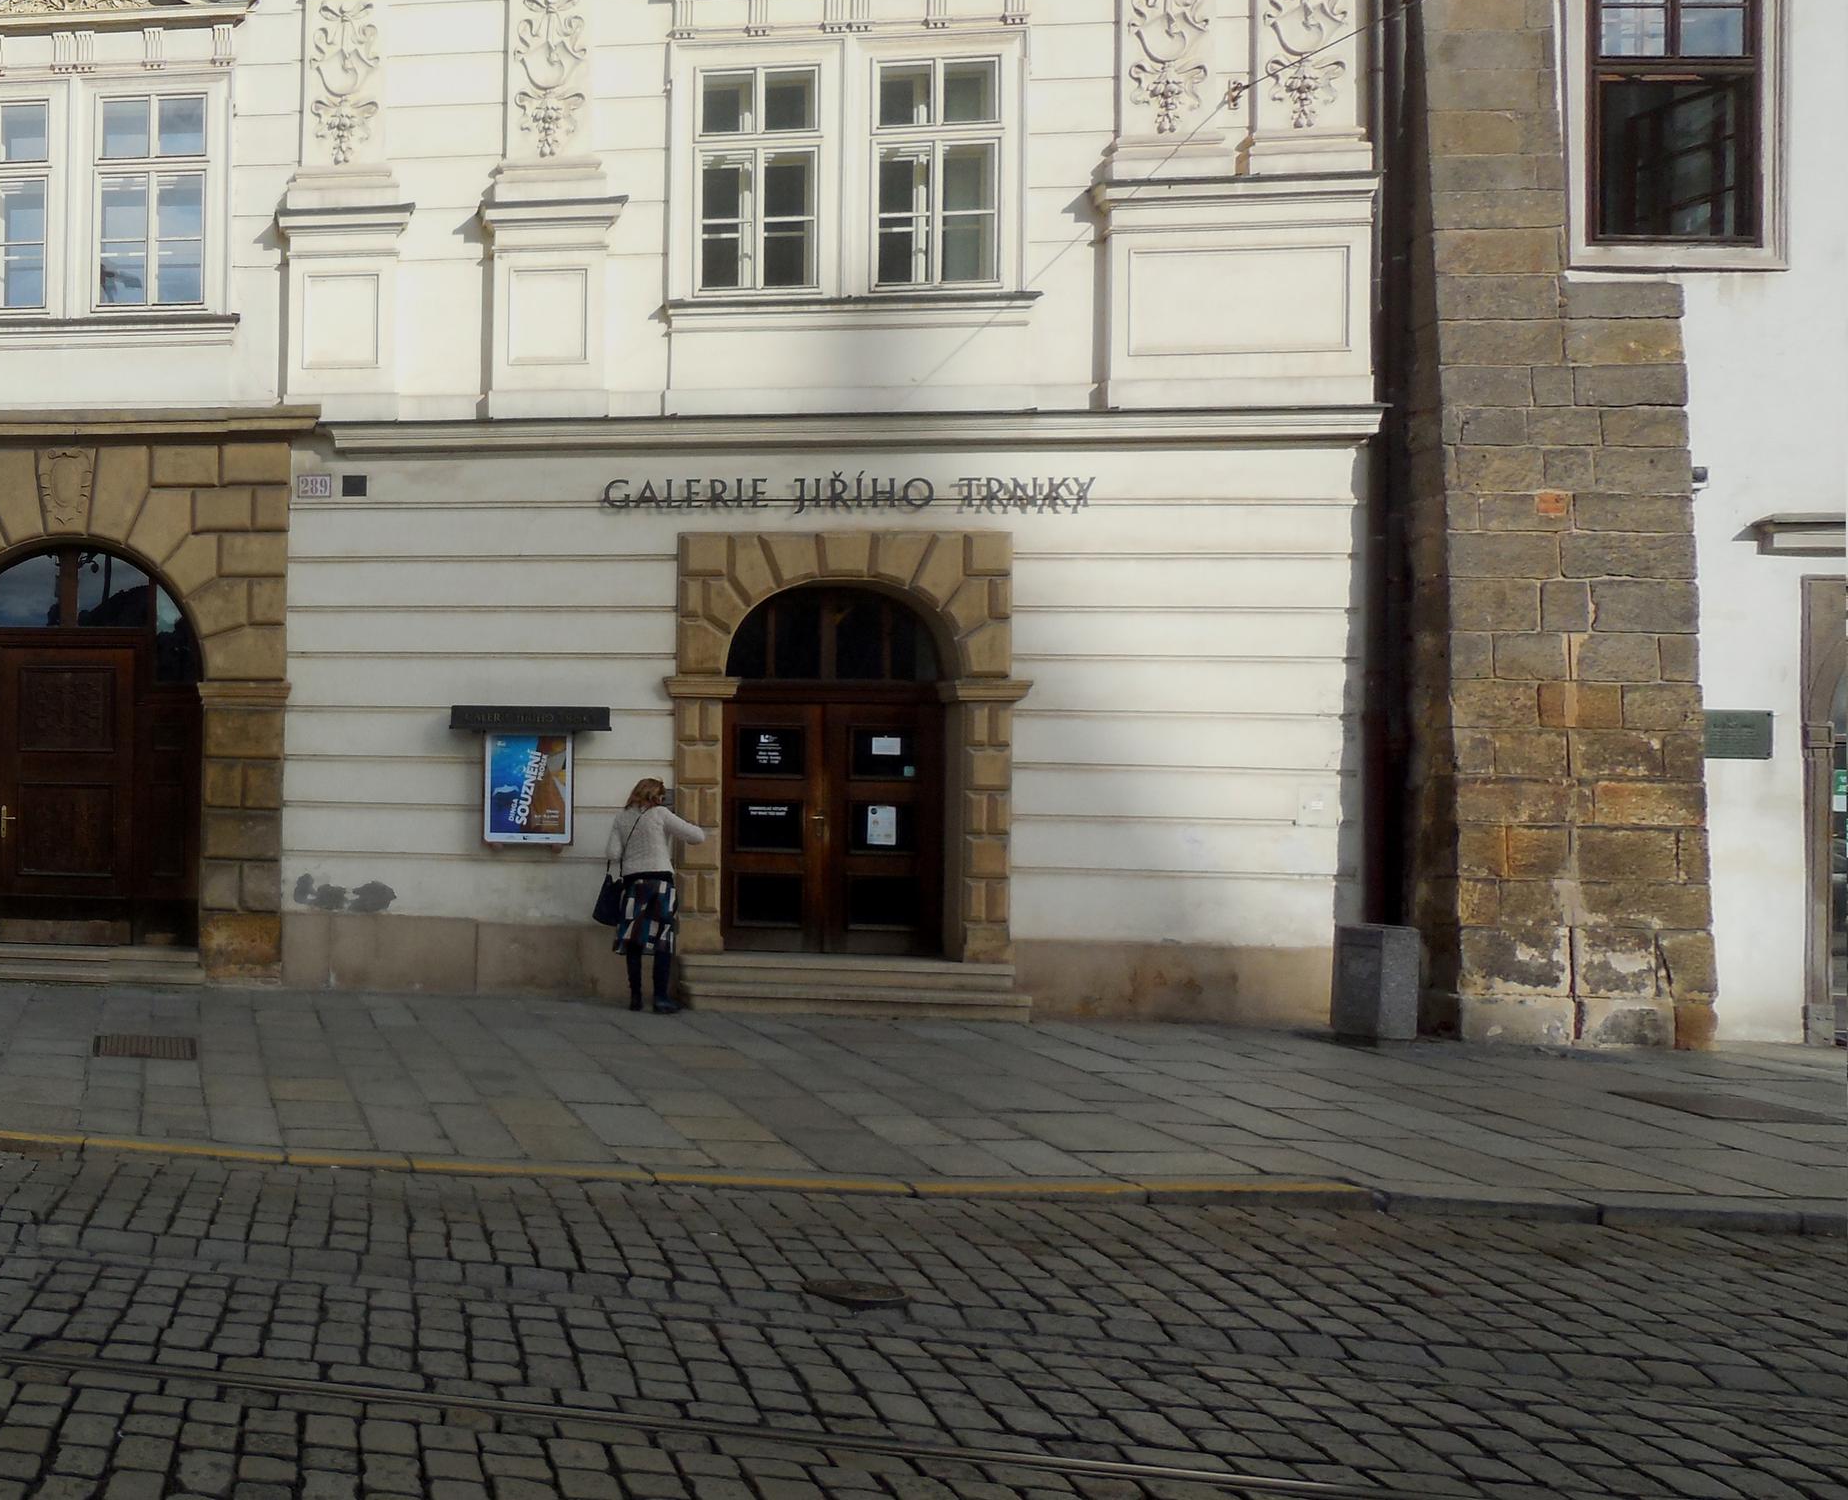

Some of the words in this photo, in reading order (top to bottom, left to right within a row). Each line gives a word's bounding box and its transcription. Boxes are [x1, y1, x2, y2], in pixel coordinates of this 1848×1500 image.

[301, 477, 328, 495] 289
[603, 478, 769, 509] GALERIE
[793, 471, 935, 514] JIŘÍHO
[958, 476, 1096, 509] TRNKY
[515, 748, 542, 826] SOUZNĚNÍ
[508, 798, 519, 822] DINGA
